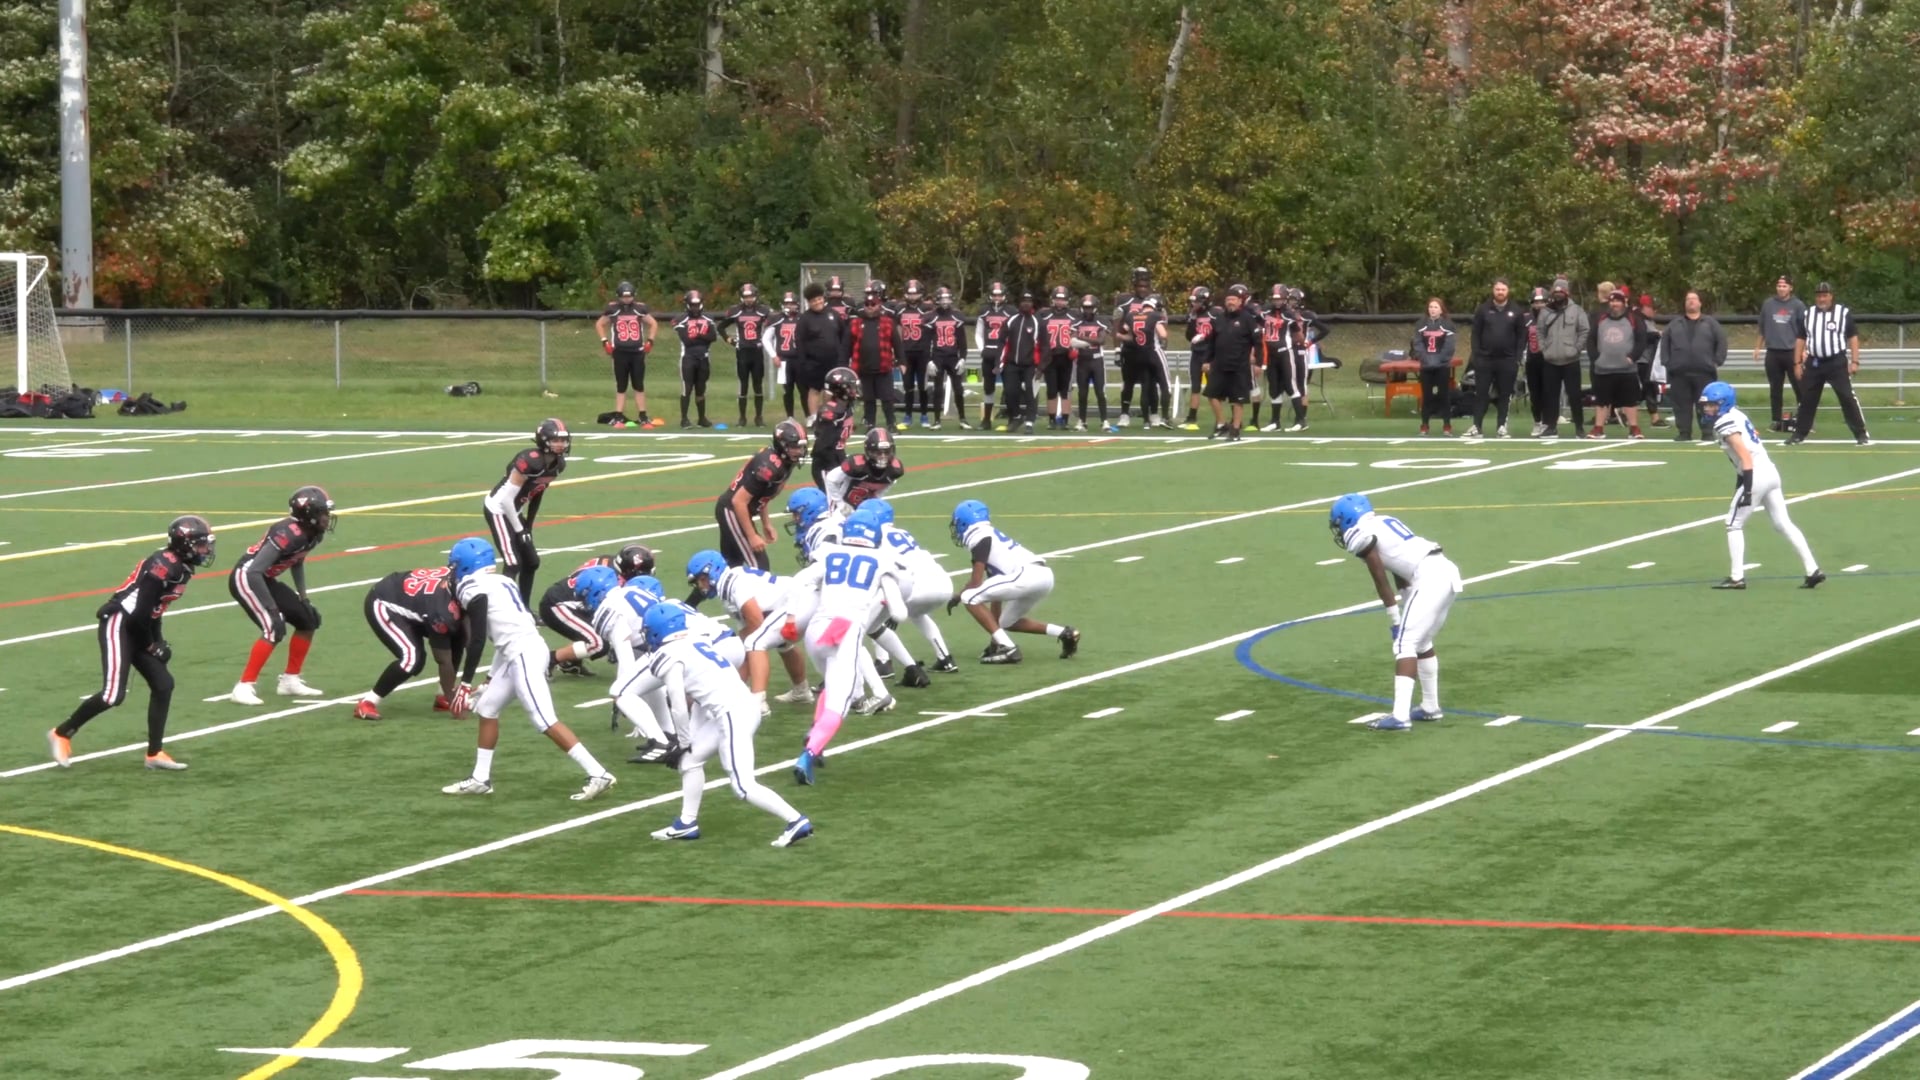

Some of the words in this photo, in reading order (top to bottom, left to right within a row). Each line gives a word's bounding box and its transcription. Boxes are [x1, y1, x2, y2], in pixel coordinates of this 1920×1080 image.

[617, 319, 639, 341] 99
[1047, 325, 1071, 348] 76
[1133, 321, 1146, 345] 5
[825, 553, 878, 590] 80
